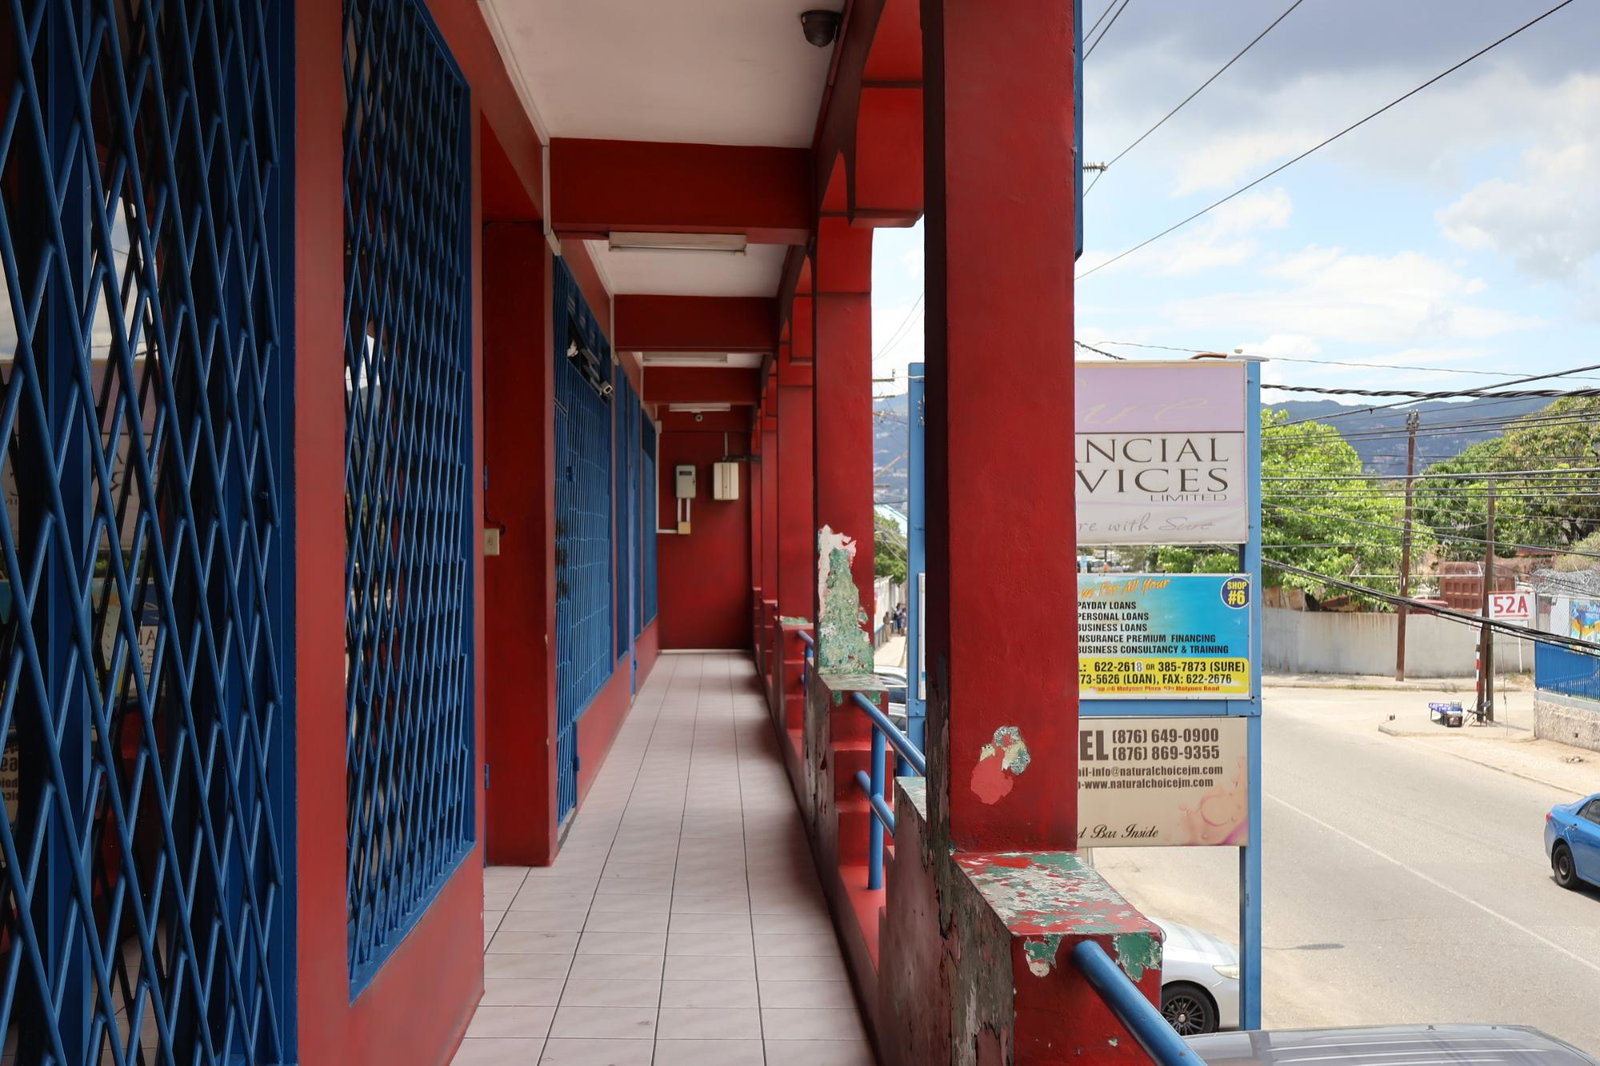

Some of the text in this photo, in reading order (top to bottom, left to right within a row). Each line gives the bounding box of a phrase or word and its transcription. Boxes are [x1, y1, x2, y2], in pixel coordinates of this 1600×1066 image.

[1075, 438, 1229, 463] NCIAL
[1108, 512, 1151, 533] with
[1226, 581, 1247, 590] SHOP
[1228, 590, 1245, 605] #6
[1110, 601, 1136, 610] LOANS
[1493, 596, 1529, 613] 52A
[1120, 624, 1147, 632] LOANS
[1126, 635, 1166, 643] PREMIUM
[1171, 635, 1215, 643] FINANCING
[1120, 646, 1178, 654] CONSULTANCY
[1181, 646, 1187, 654] &
[1190, 646, 1229, 654] TRAINING
[1094, 662, 1143, 672] 622-2618
[1158, 662, 1206, 672] 385-7873
[1210, 662, 1245, 672] (SURE)
[1123, 674, 1159, 684] (LOAN),
[1163, 674, 1183, 684] FAX:
[1186, 674, 1231, 684] 622-2676
[1080, 728, 1219, 761] EL (876) 649-0900
[1113, 746, 1219, 761] (876) 869-9355
[1090, 824, 1117, 839] Bar
[1121, 824, 1159, 839] Inside
